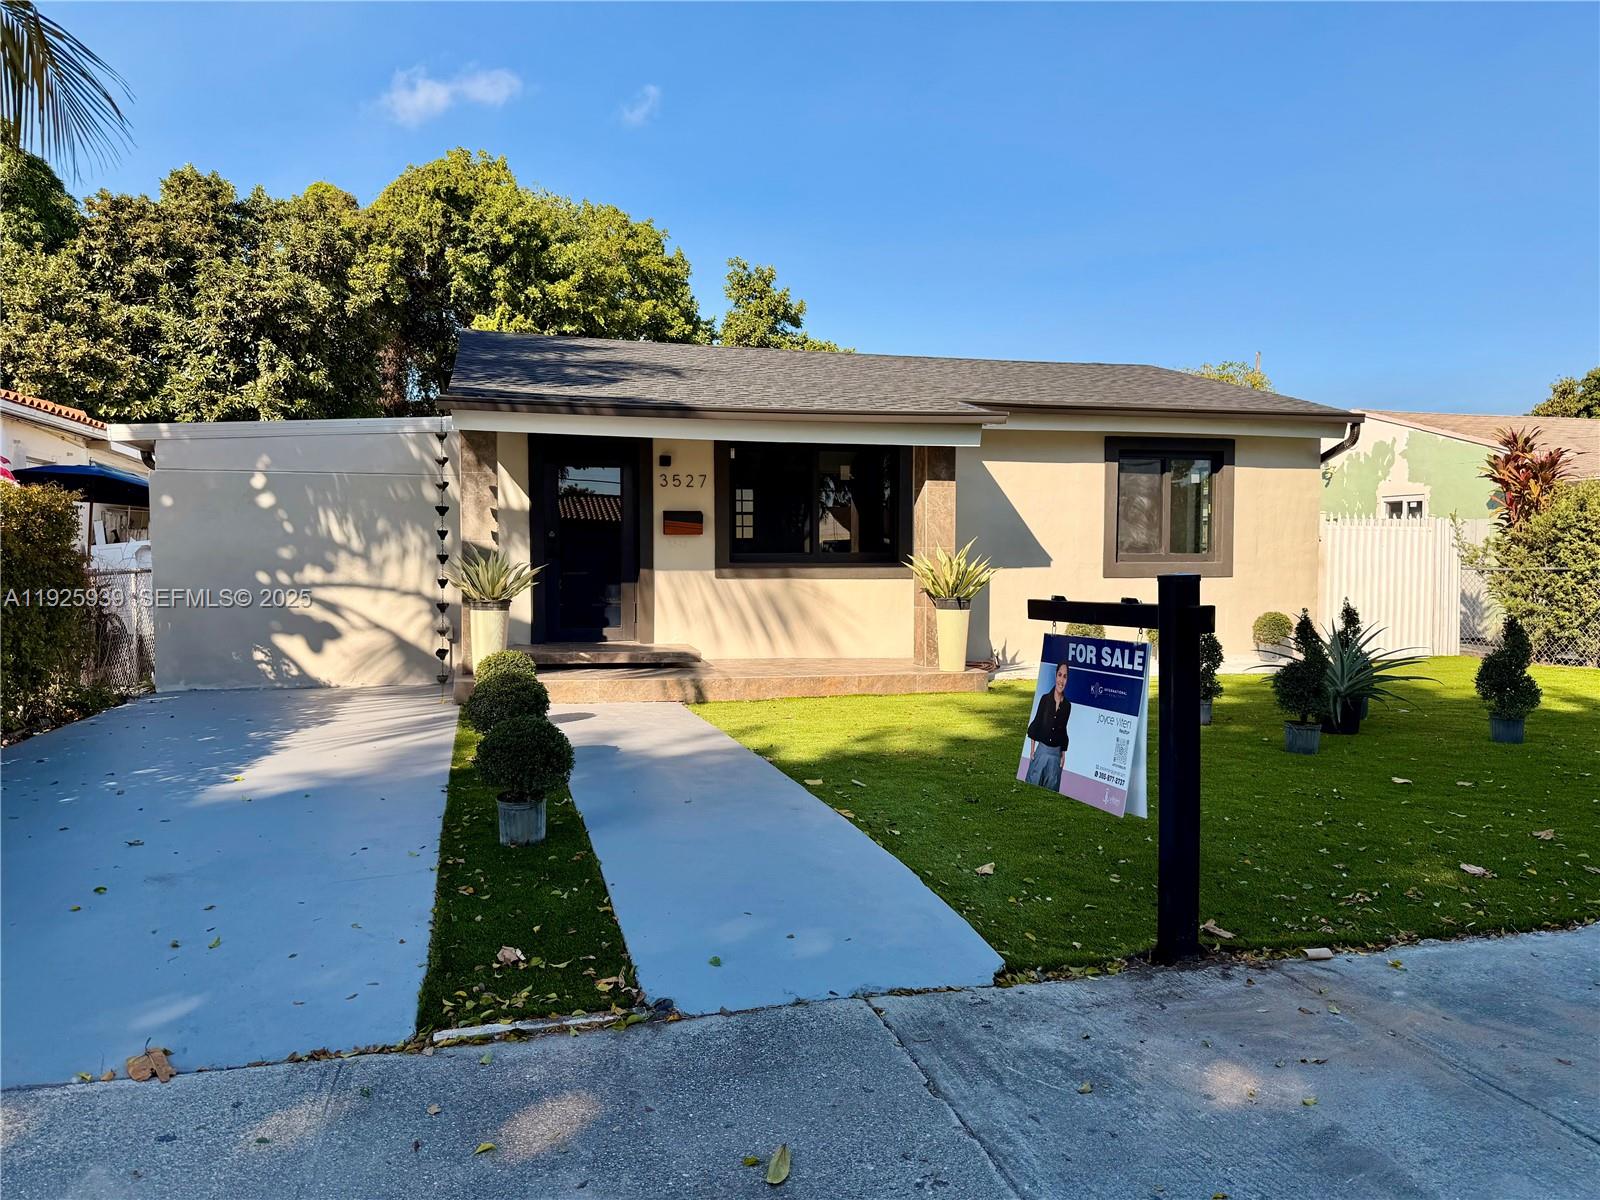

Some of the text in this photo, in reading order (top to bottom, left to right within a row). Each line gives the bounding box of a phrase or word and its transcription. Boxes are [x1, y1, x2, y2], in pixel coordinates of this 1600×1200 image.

[659, 473, 707, 488] 3527
[1068, 642, 1145, 671] FOR SALE
